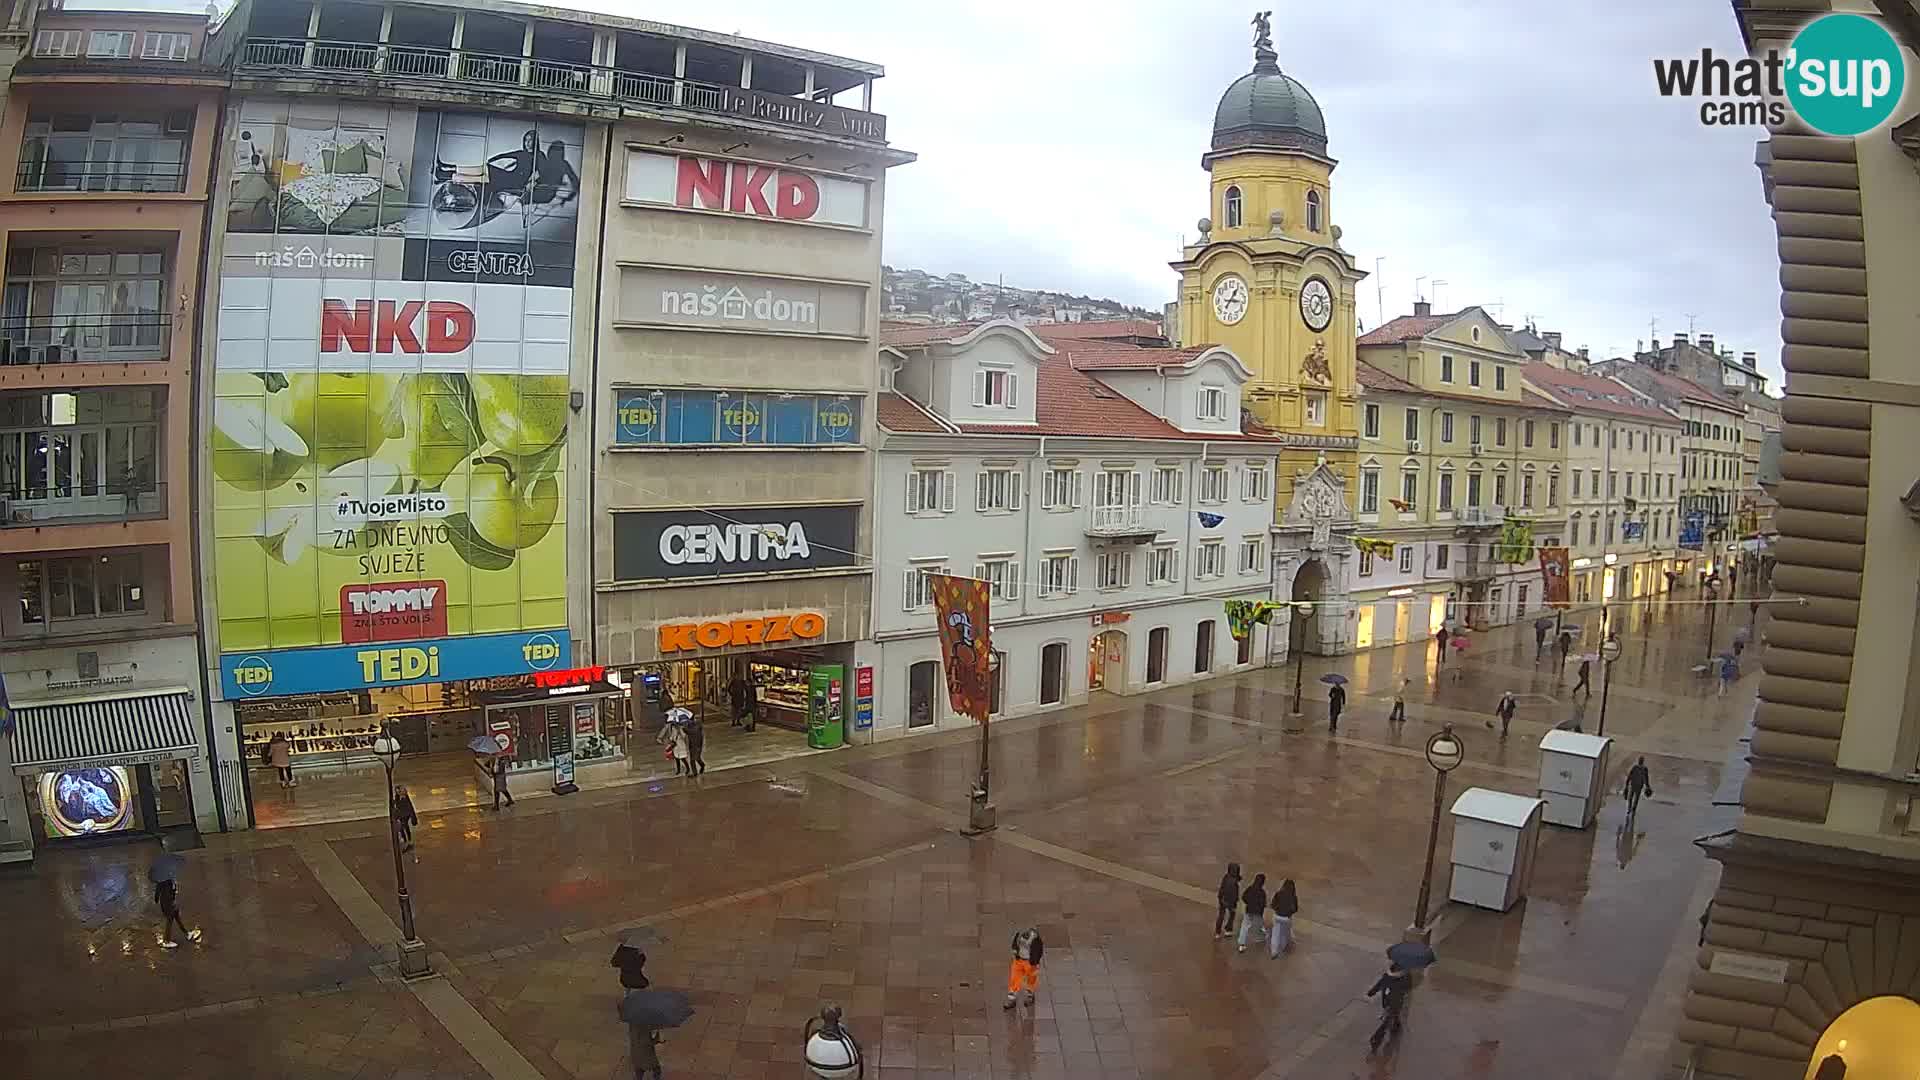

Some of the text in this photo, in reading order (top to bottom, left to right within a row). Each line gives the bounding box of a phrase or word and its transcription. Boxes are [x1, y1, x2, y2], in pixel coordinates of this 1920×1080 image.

[723, 88, 746, 112] Le
[677, 158, 820, 219] NKD
[255, 247, 365, 270] naš dom
[448, 251, 534, 276] CENTRA
[661, 285, 816, 322] naš dom
[320, 299, 476, 354] NKD
[619, 407, 657, 425] TEDi
[723, 408, 760, 426] TEDi
[337, 498, 446, 517] #TvojeMisto
[333, 524, 450, 550] ZA DNEVNO
[660, 522, 809, 564] CENTRA
[359, 547, 426, 575] SVJEŽE
[348, 587, 438, 615] TOMMY
[380, 614, 400, 627] ŠTO
[659, 613, 826, 653] KORZO
[522, 642, 560, 662] TEDi
[233, 664, 273, 685] TEDi
[357, 647, 440, 684] TEDi
